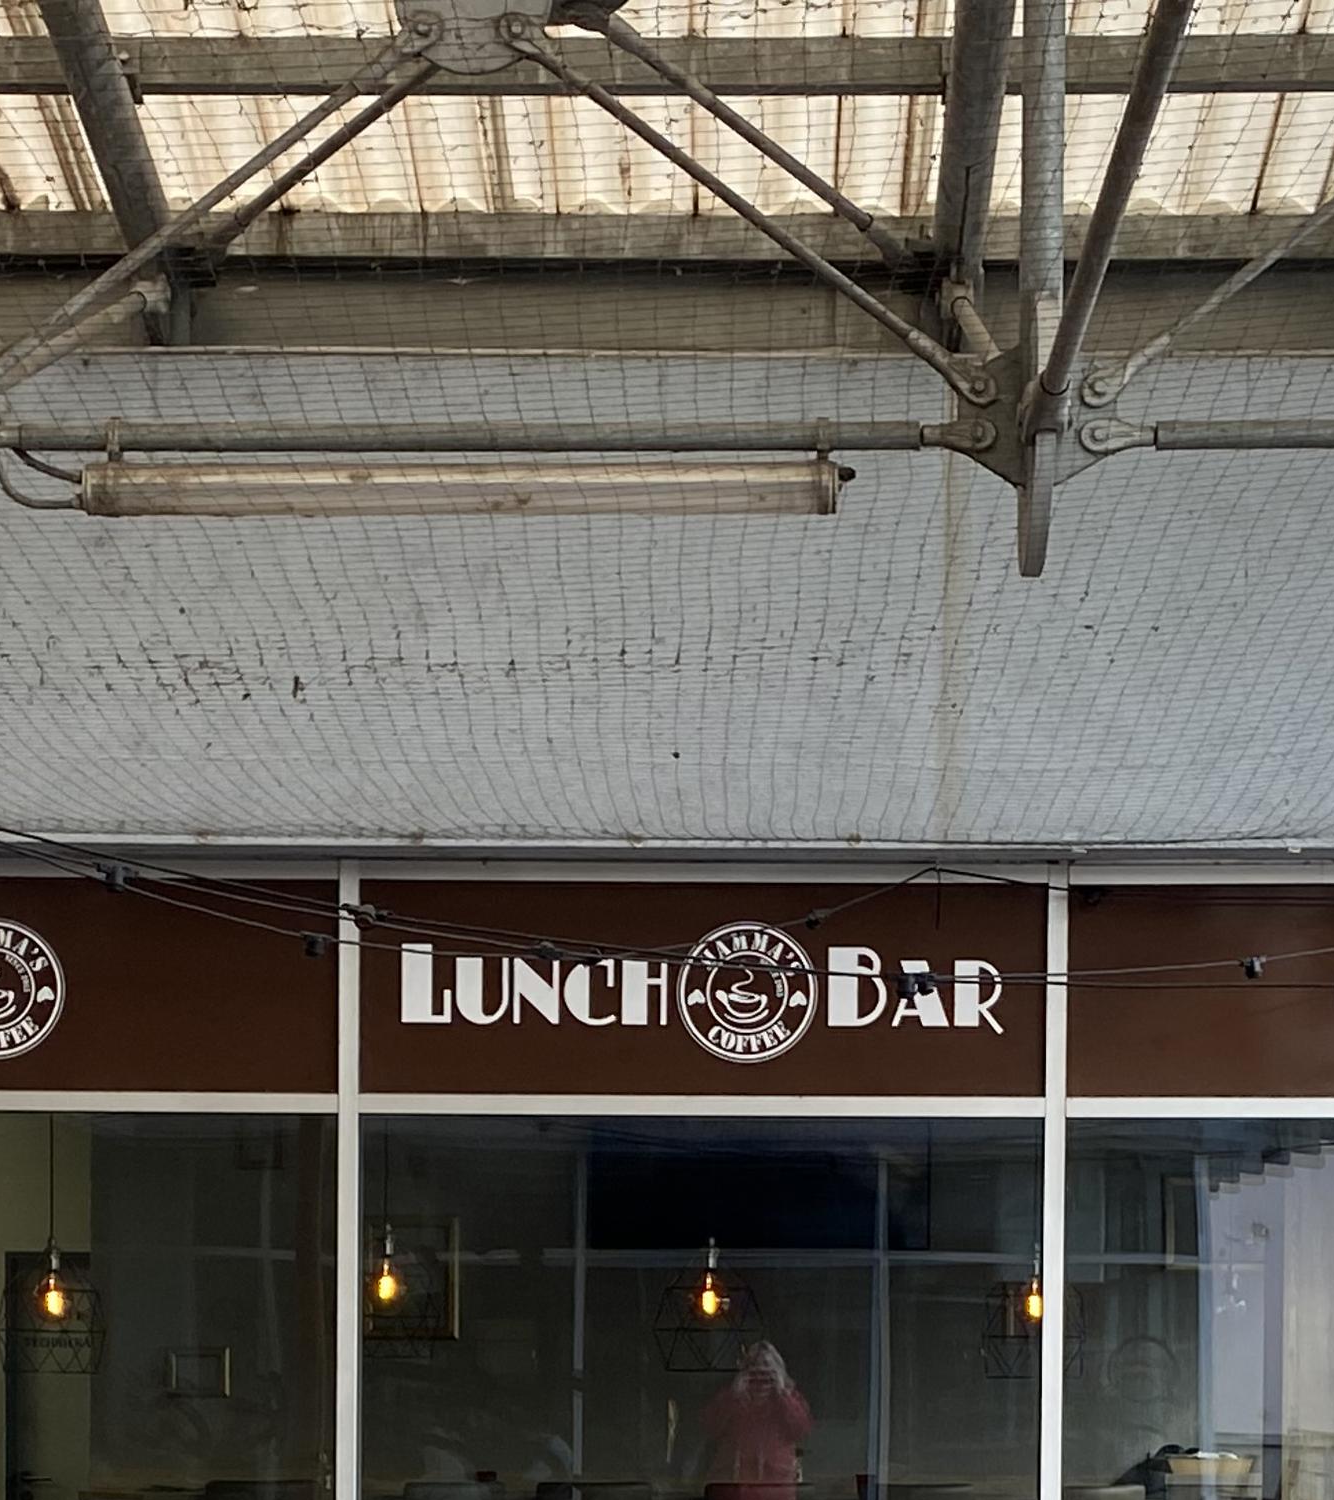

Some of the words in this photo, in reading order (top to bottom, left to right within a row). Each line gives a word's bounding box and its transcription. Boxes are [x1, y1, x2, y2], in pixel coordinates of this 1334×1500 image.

[401, 943, 670, 1027] LUNCH
[827, 945, 1004, 1035] BAR
[707, 1020, 791, 1054] COFFEE
